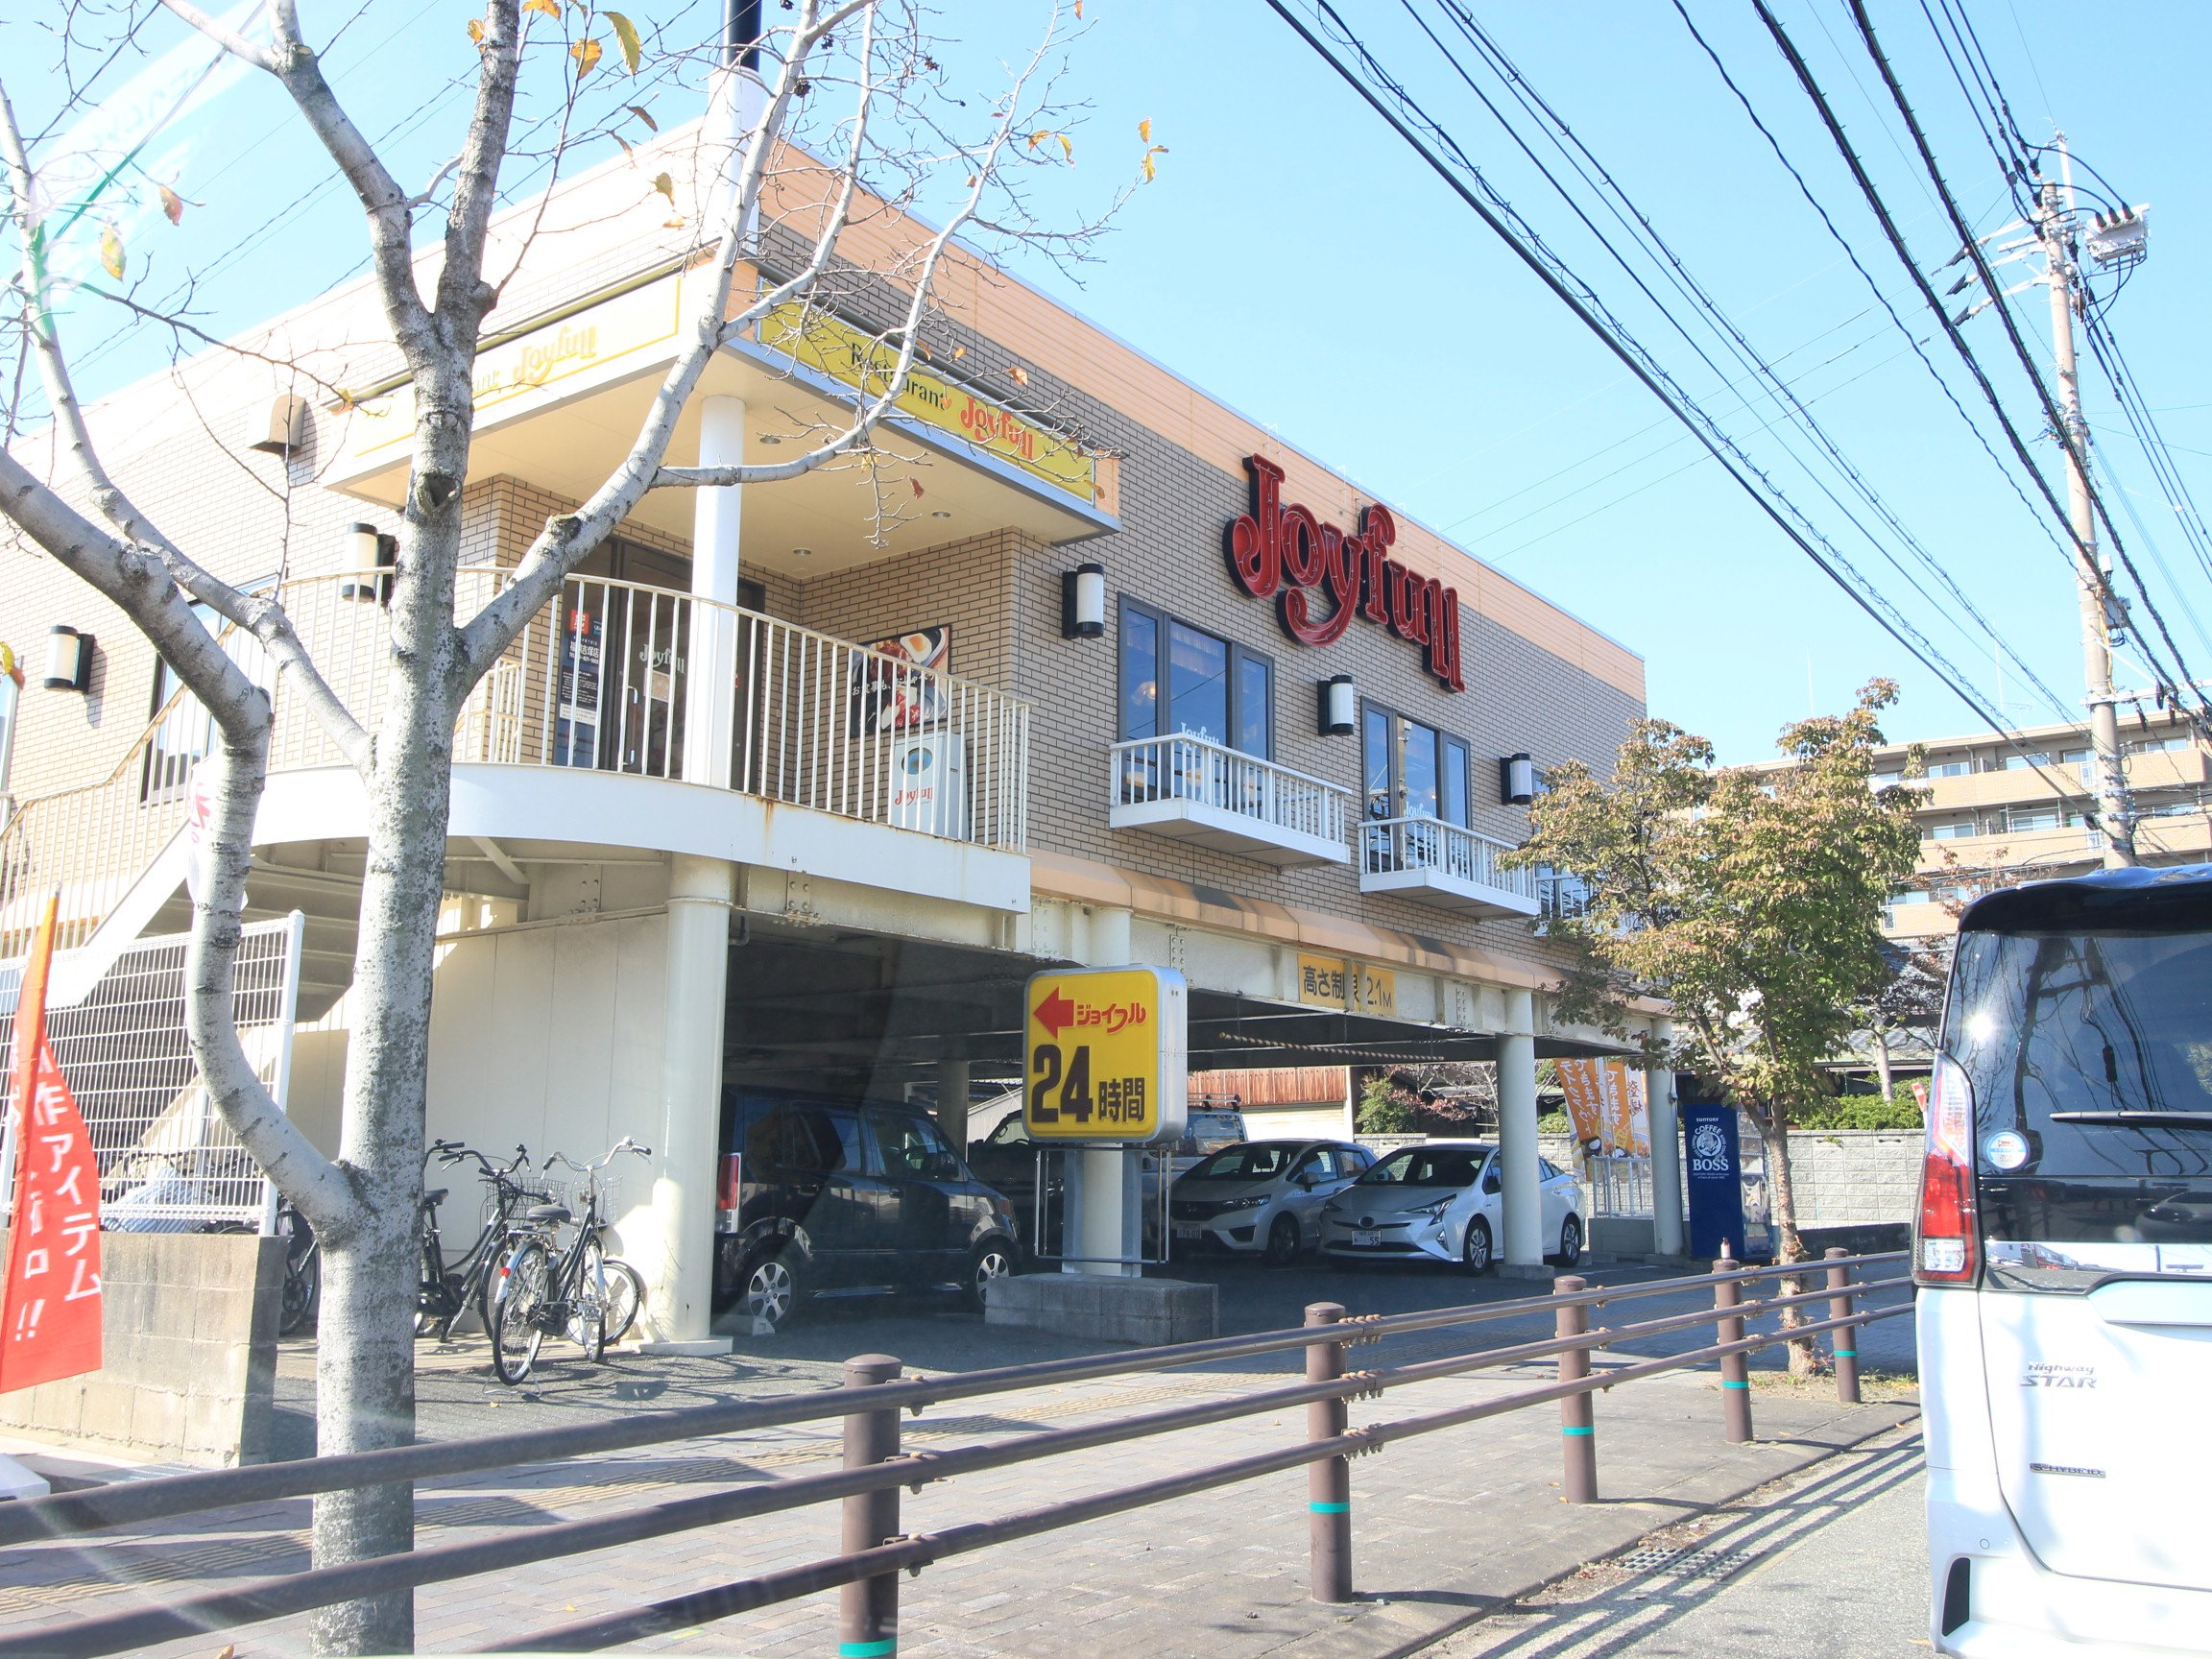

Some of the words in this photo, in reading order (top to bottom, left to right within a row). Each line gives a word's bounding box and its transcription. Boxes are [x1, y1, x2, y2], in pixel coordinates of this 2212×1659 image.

[513, 325, 597, 387] Joyfull
[851, 343, 946, 411] Rsturant
[960, 396, 1034, 462] Joyfull
[1222, 452, 1465, 693] Joyfull
[639, 644, 685, 673] Joyfll
[1076, 1002, 1147, 1034] ジョイフル
[1031, 1044, 1145, 1123] 24時間
[1695, 1124, 1722, 1135] COFFEE
[1693, 1159, 1729, 1171] BOSS
[2019, 1374, 2098, 1388] STAR
[2028, 1363, 2095, 1375] Highway
